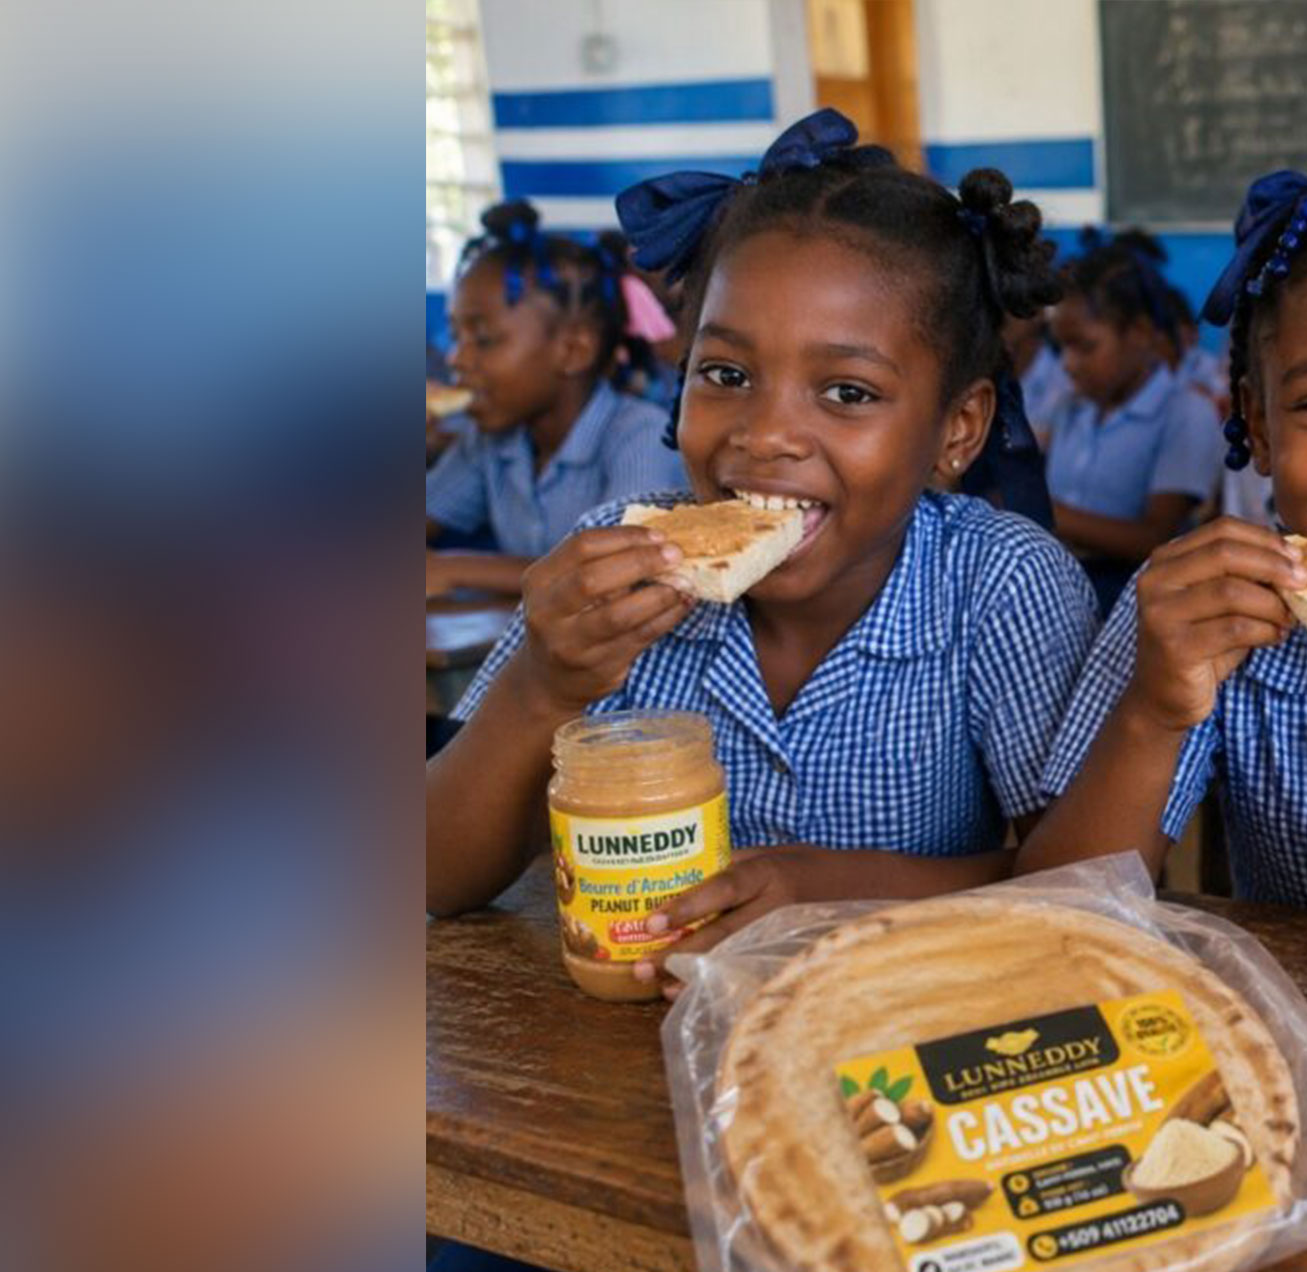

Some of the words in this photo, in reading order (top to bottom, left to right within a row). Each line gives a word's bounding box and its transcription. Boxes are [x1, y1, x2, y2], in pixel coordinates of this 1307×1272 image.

[577, 822, 698, 856] LUNNEDDY
[591, 898, 641, 913] PEANUT
[943, 1036, 1102, 1093] LUNNEDDY
[946, 1063, 1165, 1161] CASSAVE
